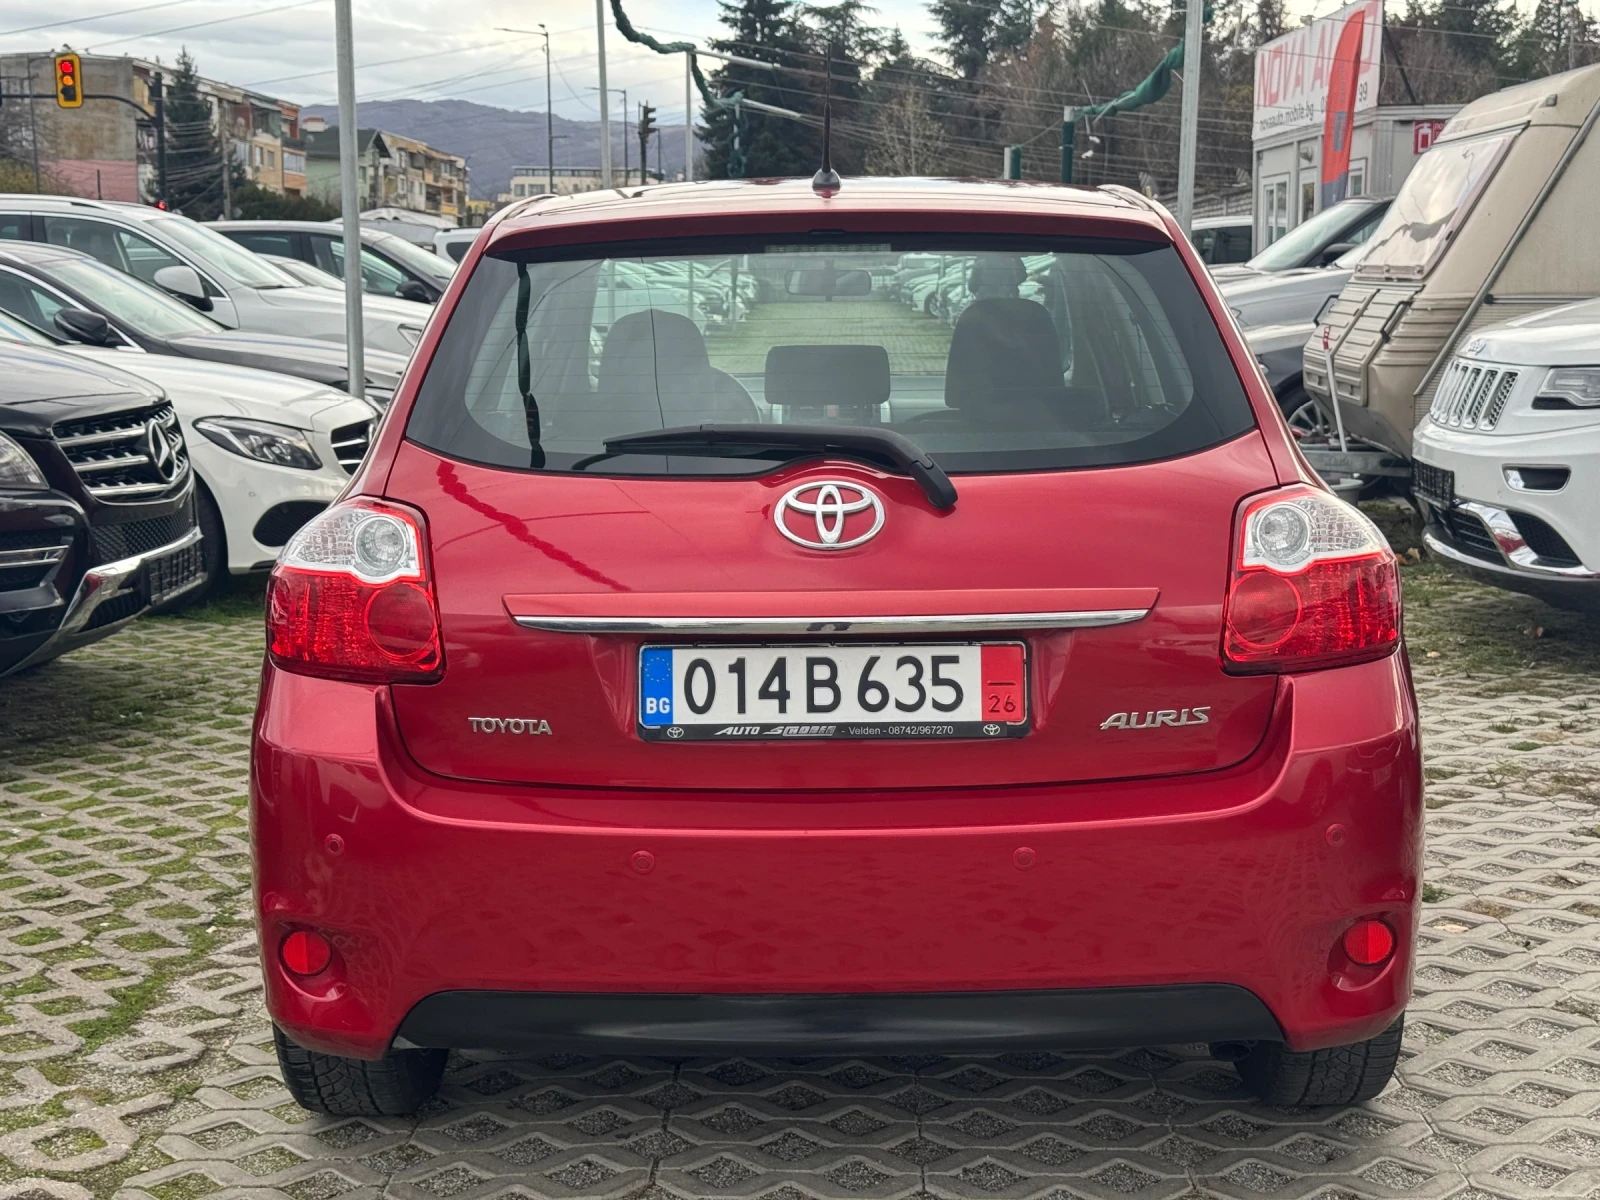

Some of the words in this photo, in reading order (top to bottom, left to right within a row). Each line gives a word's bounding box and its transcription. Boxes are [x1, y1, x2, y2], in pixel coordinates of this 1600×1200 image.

[1256, 32, 1305, 111] NOVA
[646, 697, 670, 714] BG
[988, 695, 1016, 713] 26
[468, 717, 552, 735] TOYOTA
[1099, 706, 1211, 730] AURIS
[714, 726, 760, 736] AUTO
[848, 726, 880, 735] Velden
[888, 725, 954, 735] 08742/967270
